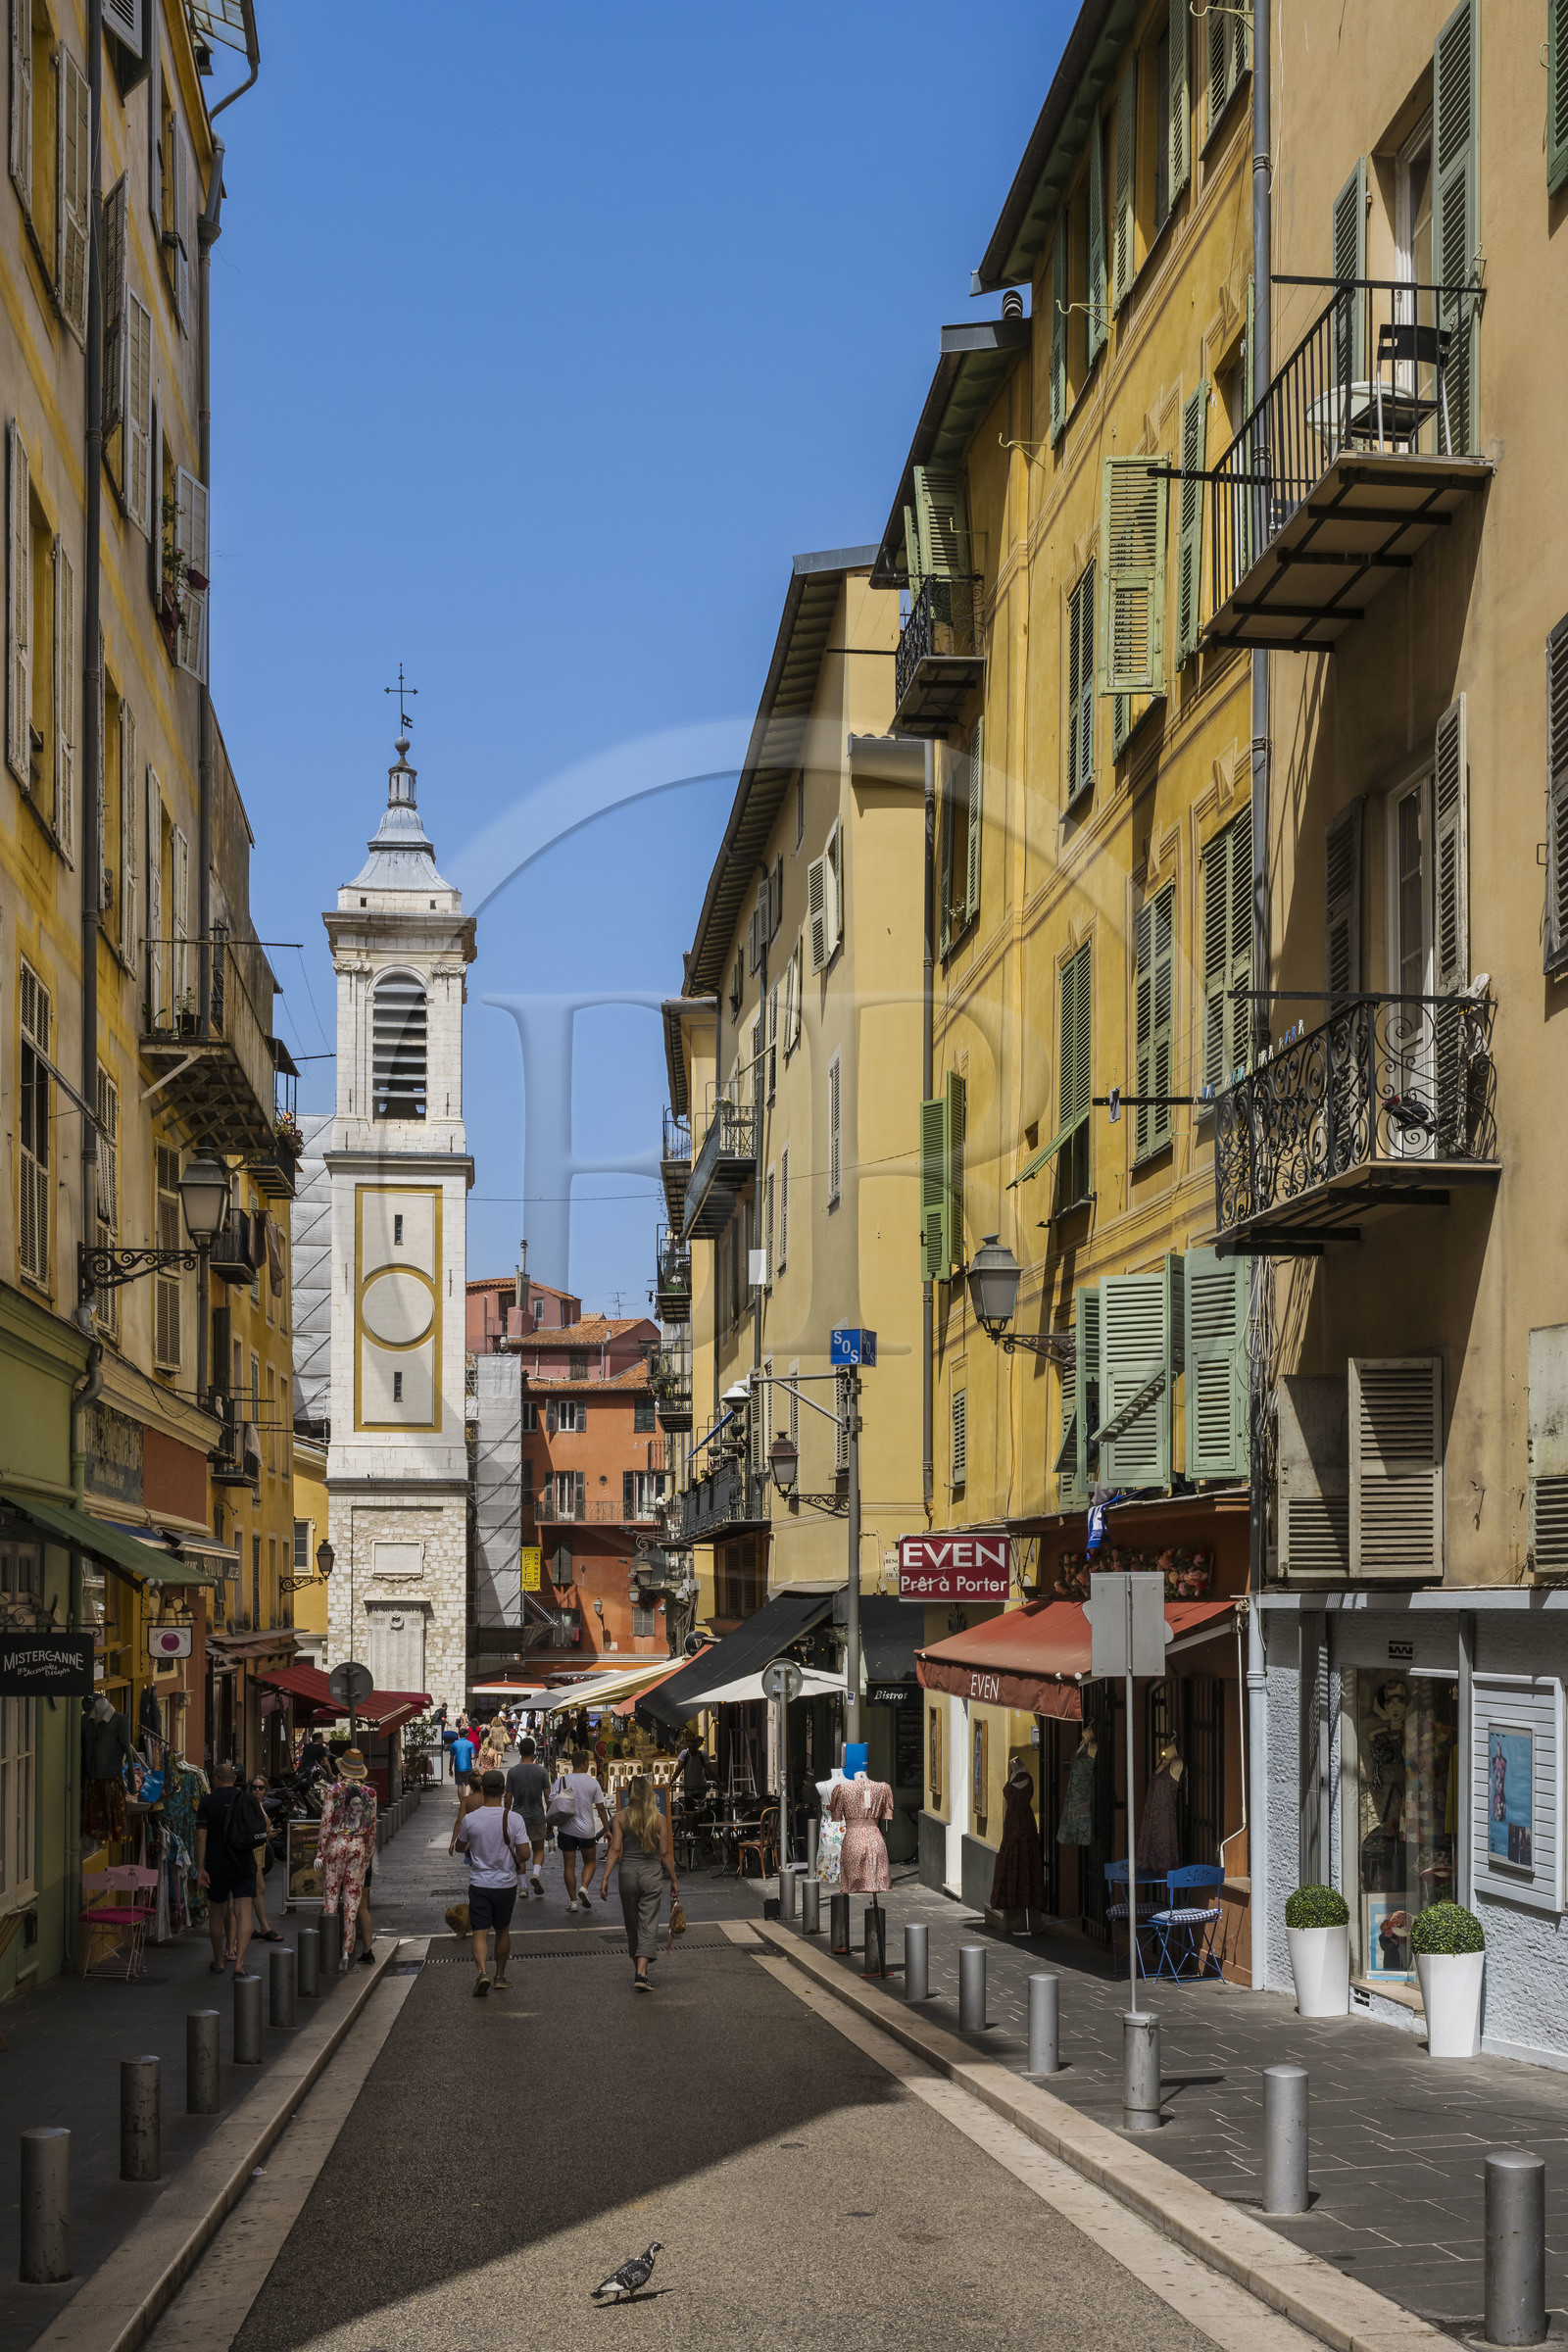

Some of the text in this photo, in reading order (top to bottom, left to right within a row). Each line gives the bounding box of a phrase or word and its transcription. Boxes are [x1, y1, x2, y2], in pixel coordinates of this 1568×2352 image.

[833, 1330, 859, 1363] SOS
[862, 1330, 876, 1366] SOS
[903, 1542, 1005, 1568] EVEN
[901, 1576, 1007, 1592] Prêt à Porter
[874, 1690, 908, 1700] Bistrot
[970, 1673, 1000, 1700] EVEN
